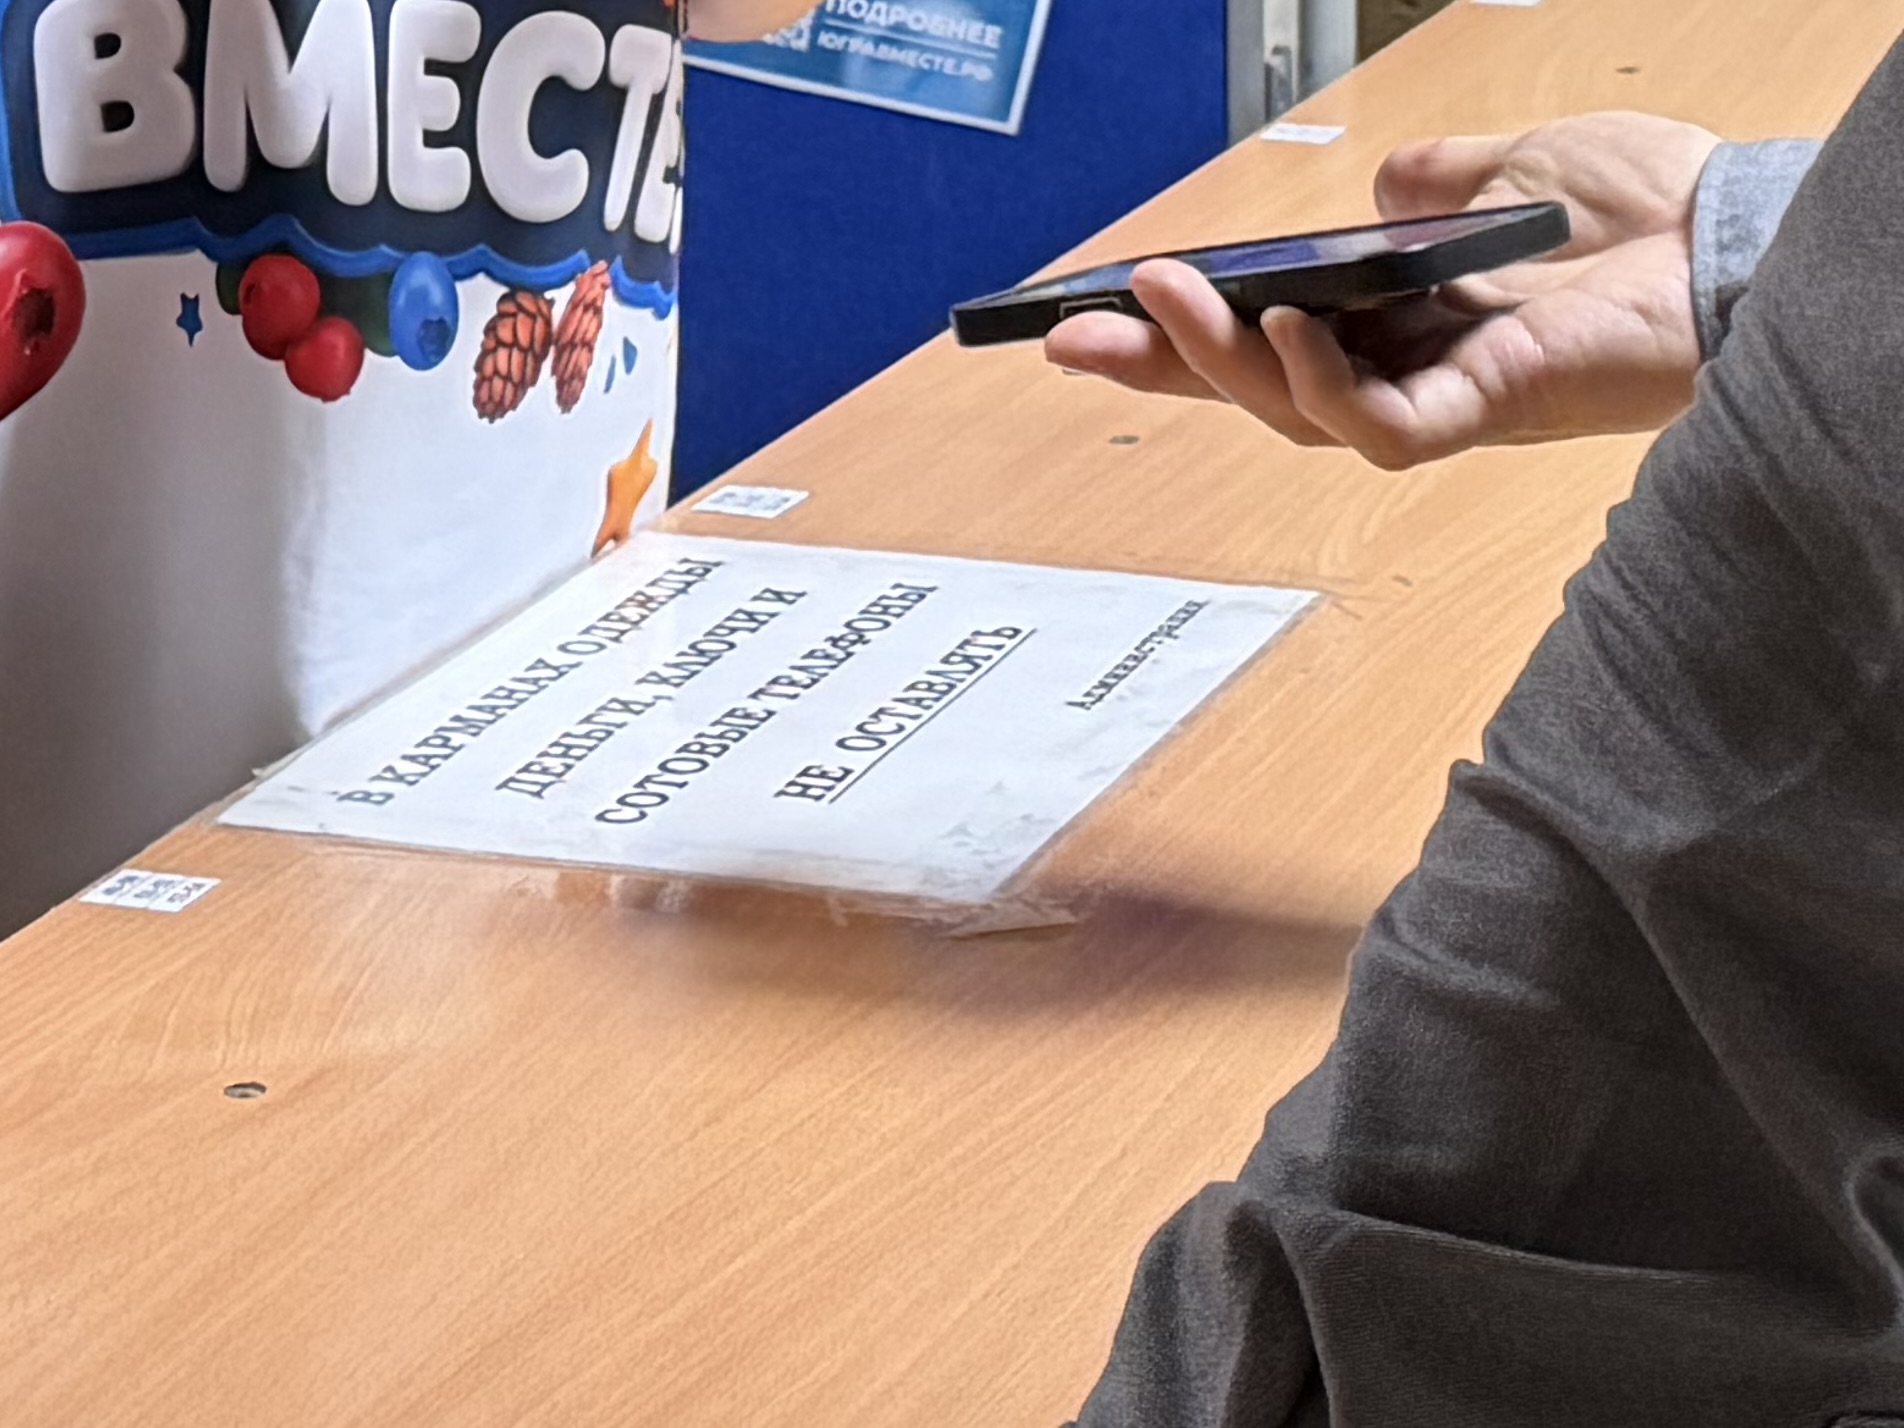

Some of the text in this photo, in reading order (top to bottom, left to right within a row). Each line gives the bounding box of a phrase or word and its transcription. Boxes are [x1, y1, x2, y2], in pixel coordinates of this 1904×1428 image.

[817, 30, 994, 82] ЮГРАВМЕСТЕ.РФ
[336, 556, 726, 807] В КАРМАНАХ ОДЕЖДЫ
[494, 587, 808, 800] ДЕНЬГИ, КЛЮЧИ И
[594, 582, 940, 826] СОТОВЫЕ ТЕЛЕФОНЫ
[773, 623, 1025, 803] НЕ ОСТАВЛЯТЬ
